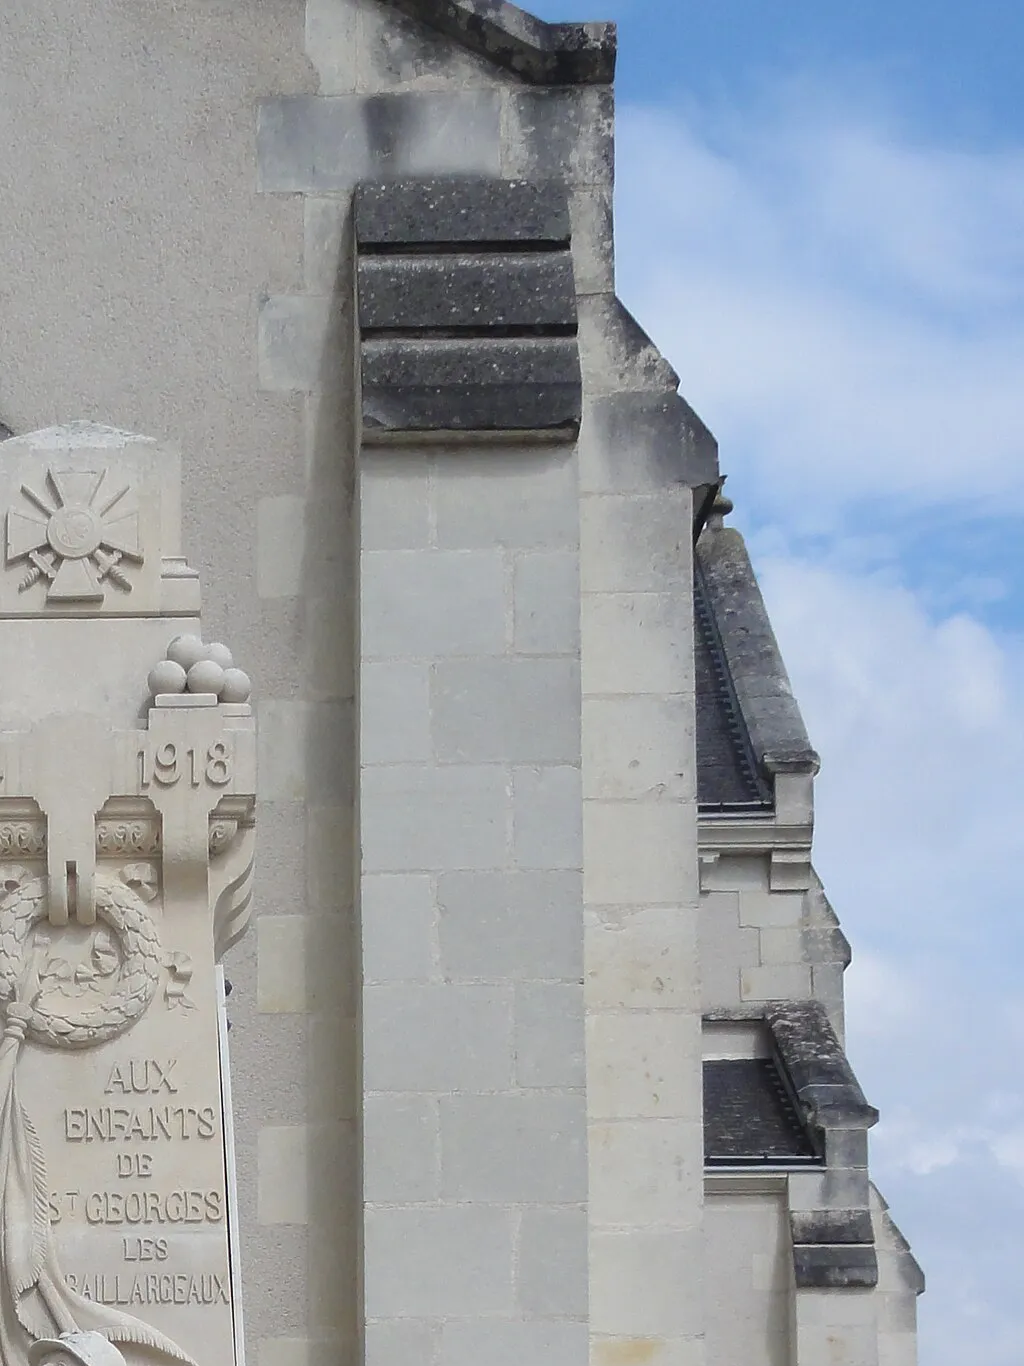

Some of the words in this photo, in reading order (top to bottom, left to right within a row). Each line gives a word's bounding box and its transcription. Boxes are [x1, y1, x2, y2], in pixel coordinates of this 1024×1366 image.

[137, 743, 233, 789] 1918
[104, 1060, 178, 1094] AUX
[64, 1107, 216, 1142] ENFANTS
[117, 1154, 153, 1178] DE
[85, 1191, 224, 1225] GEORGES
[123, 1238, 169, 1261] LES
